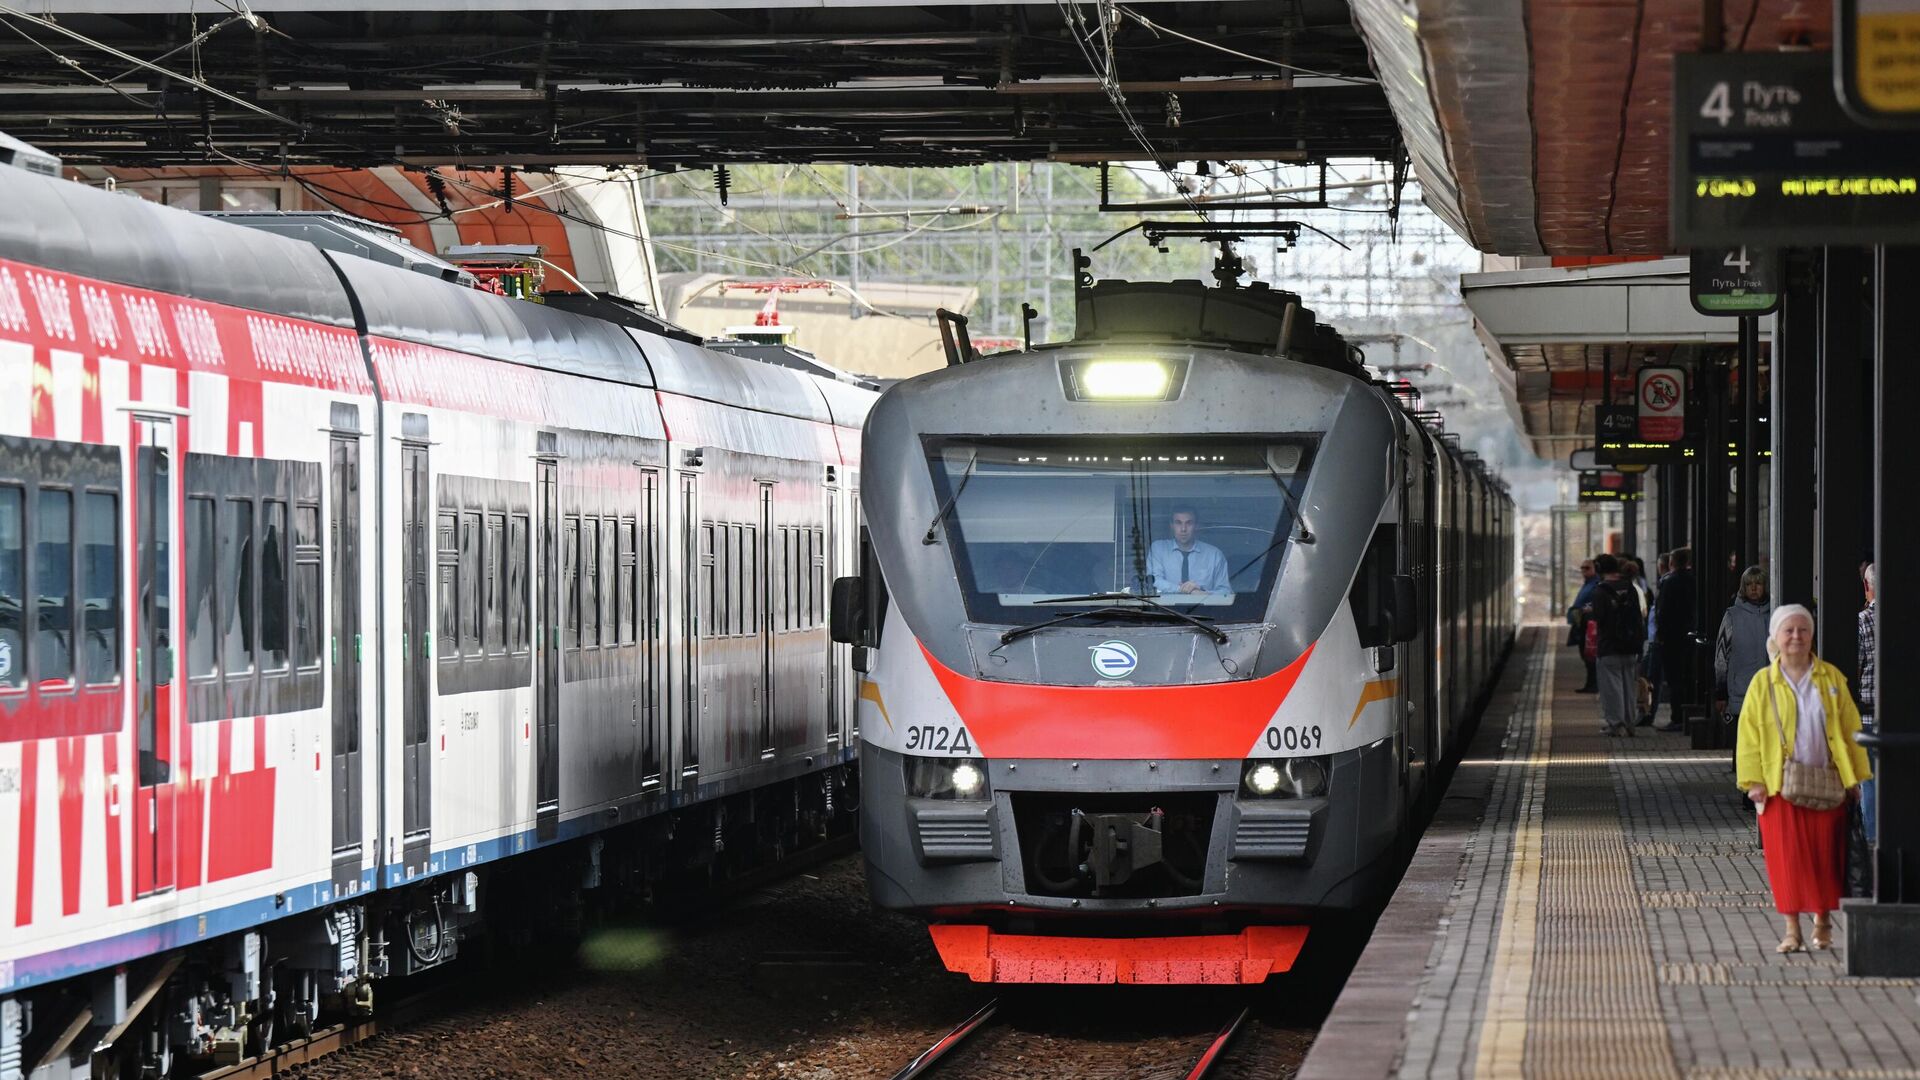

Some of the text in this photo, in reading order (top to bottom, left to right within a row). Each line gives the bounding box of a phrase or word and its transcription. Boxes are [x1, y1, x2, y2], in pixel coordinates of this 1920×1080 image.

[1701, 82, 1733, 127] 4
[1743, 81, 1801, 109] Путь
[1723, 245, 1751, 274] 4
[1712, 279, 1736, 289] Путь
[1743, 279, 1762, 287] Track
[1603, 415, 1613, 428] 4
[905, 725, 972, 754] ЭП2Д
[1267, 725, 1322, 751] 0069
